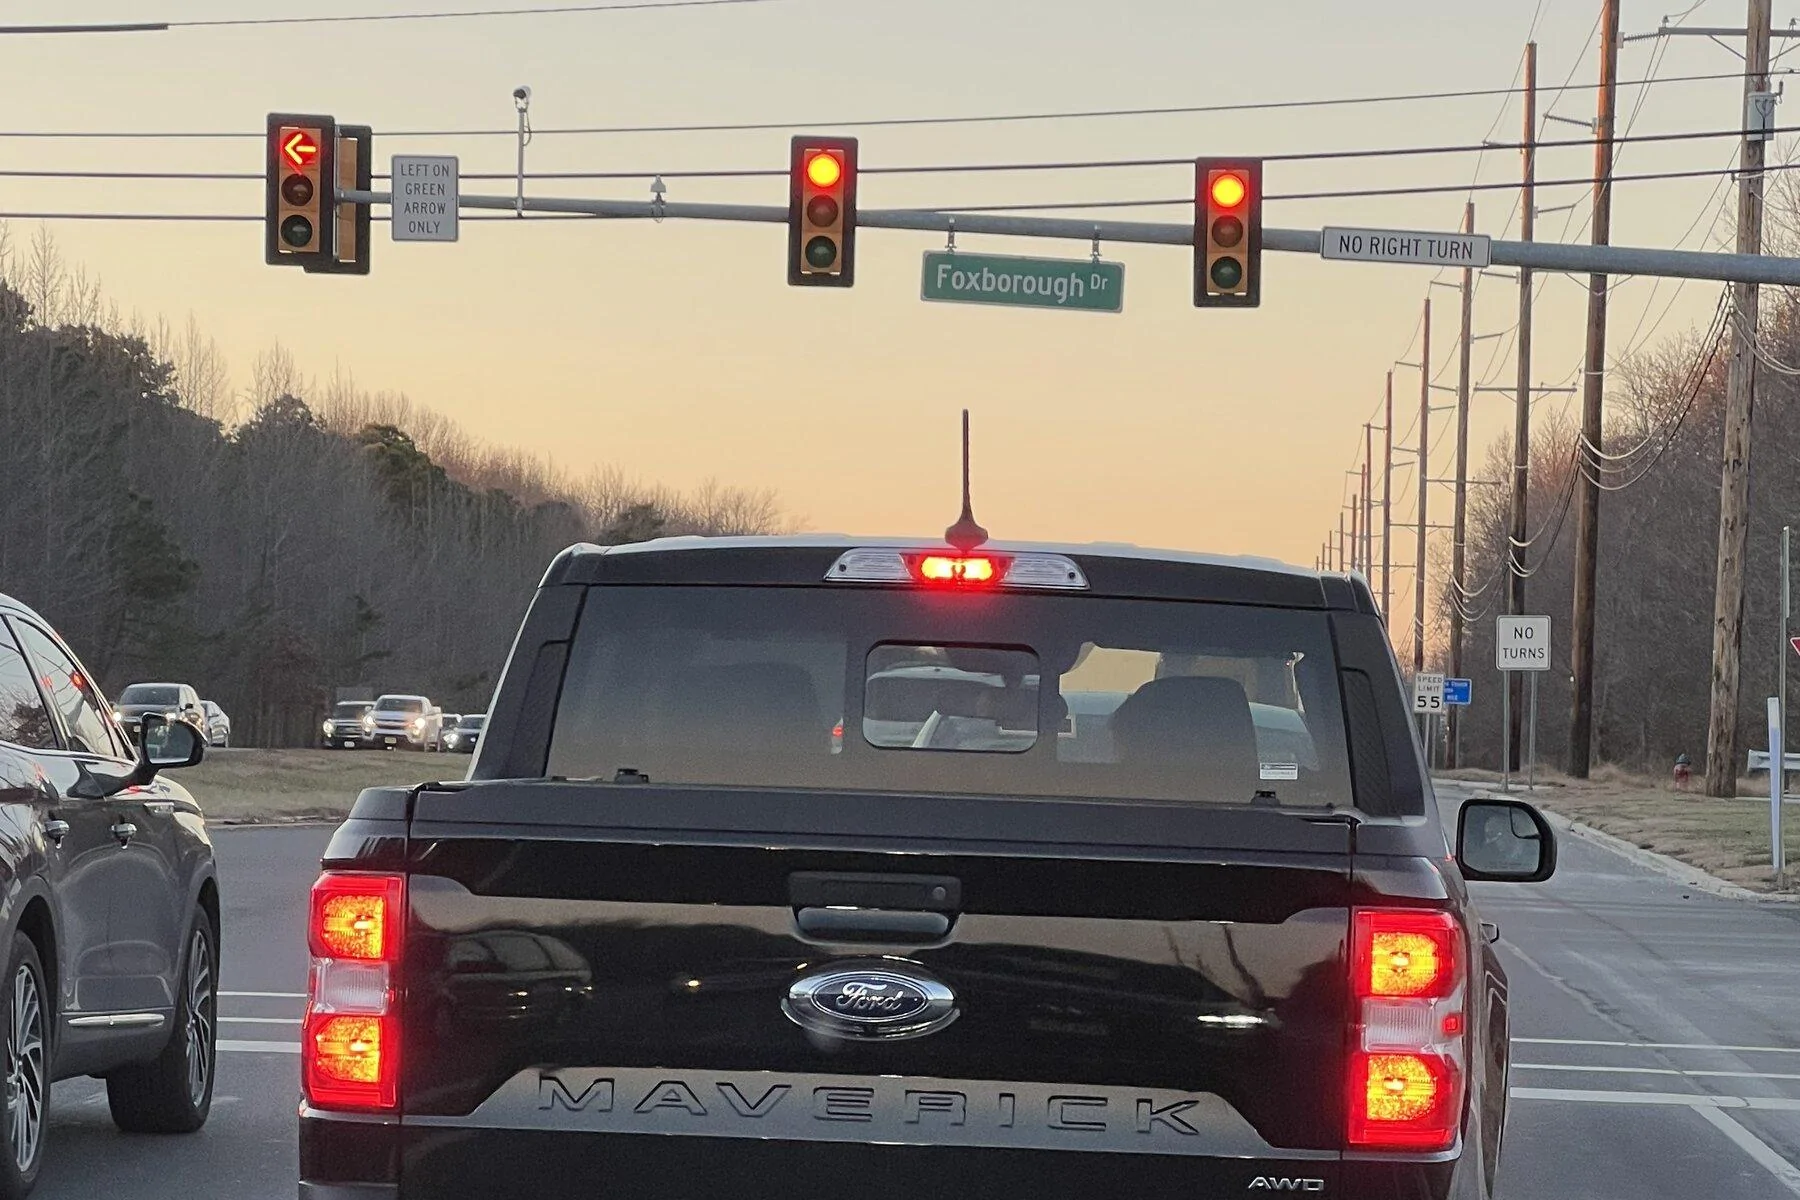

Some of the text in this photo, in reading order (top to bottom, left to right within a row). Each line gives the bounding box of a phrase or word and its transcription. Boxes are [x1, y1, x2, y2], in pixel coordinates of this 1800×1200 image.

[401, 164, 449, 177] LEFT ON
[405, 182, 445, 196] GREEN
[404, 202, 446, 215] ARROW
[408, 220, 440, 233] ONLY
[1339, 235, 1473, 260] NO RIGHT TURN
[937, 264, 1108, 304] Foxborough Dr
[1514, 626, 1534, 640] NO
[1503, 648, 1545, 660] TURNS
[1417, 675, 1442, 683] SPEED
[1417, 695, 1440, 709] 55
[835, 981, 903, 1011] Ford
[538, 1075, 1200, 1136] MAVERICK
[1248, 1176, 1324, 1191] AWD
